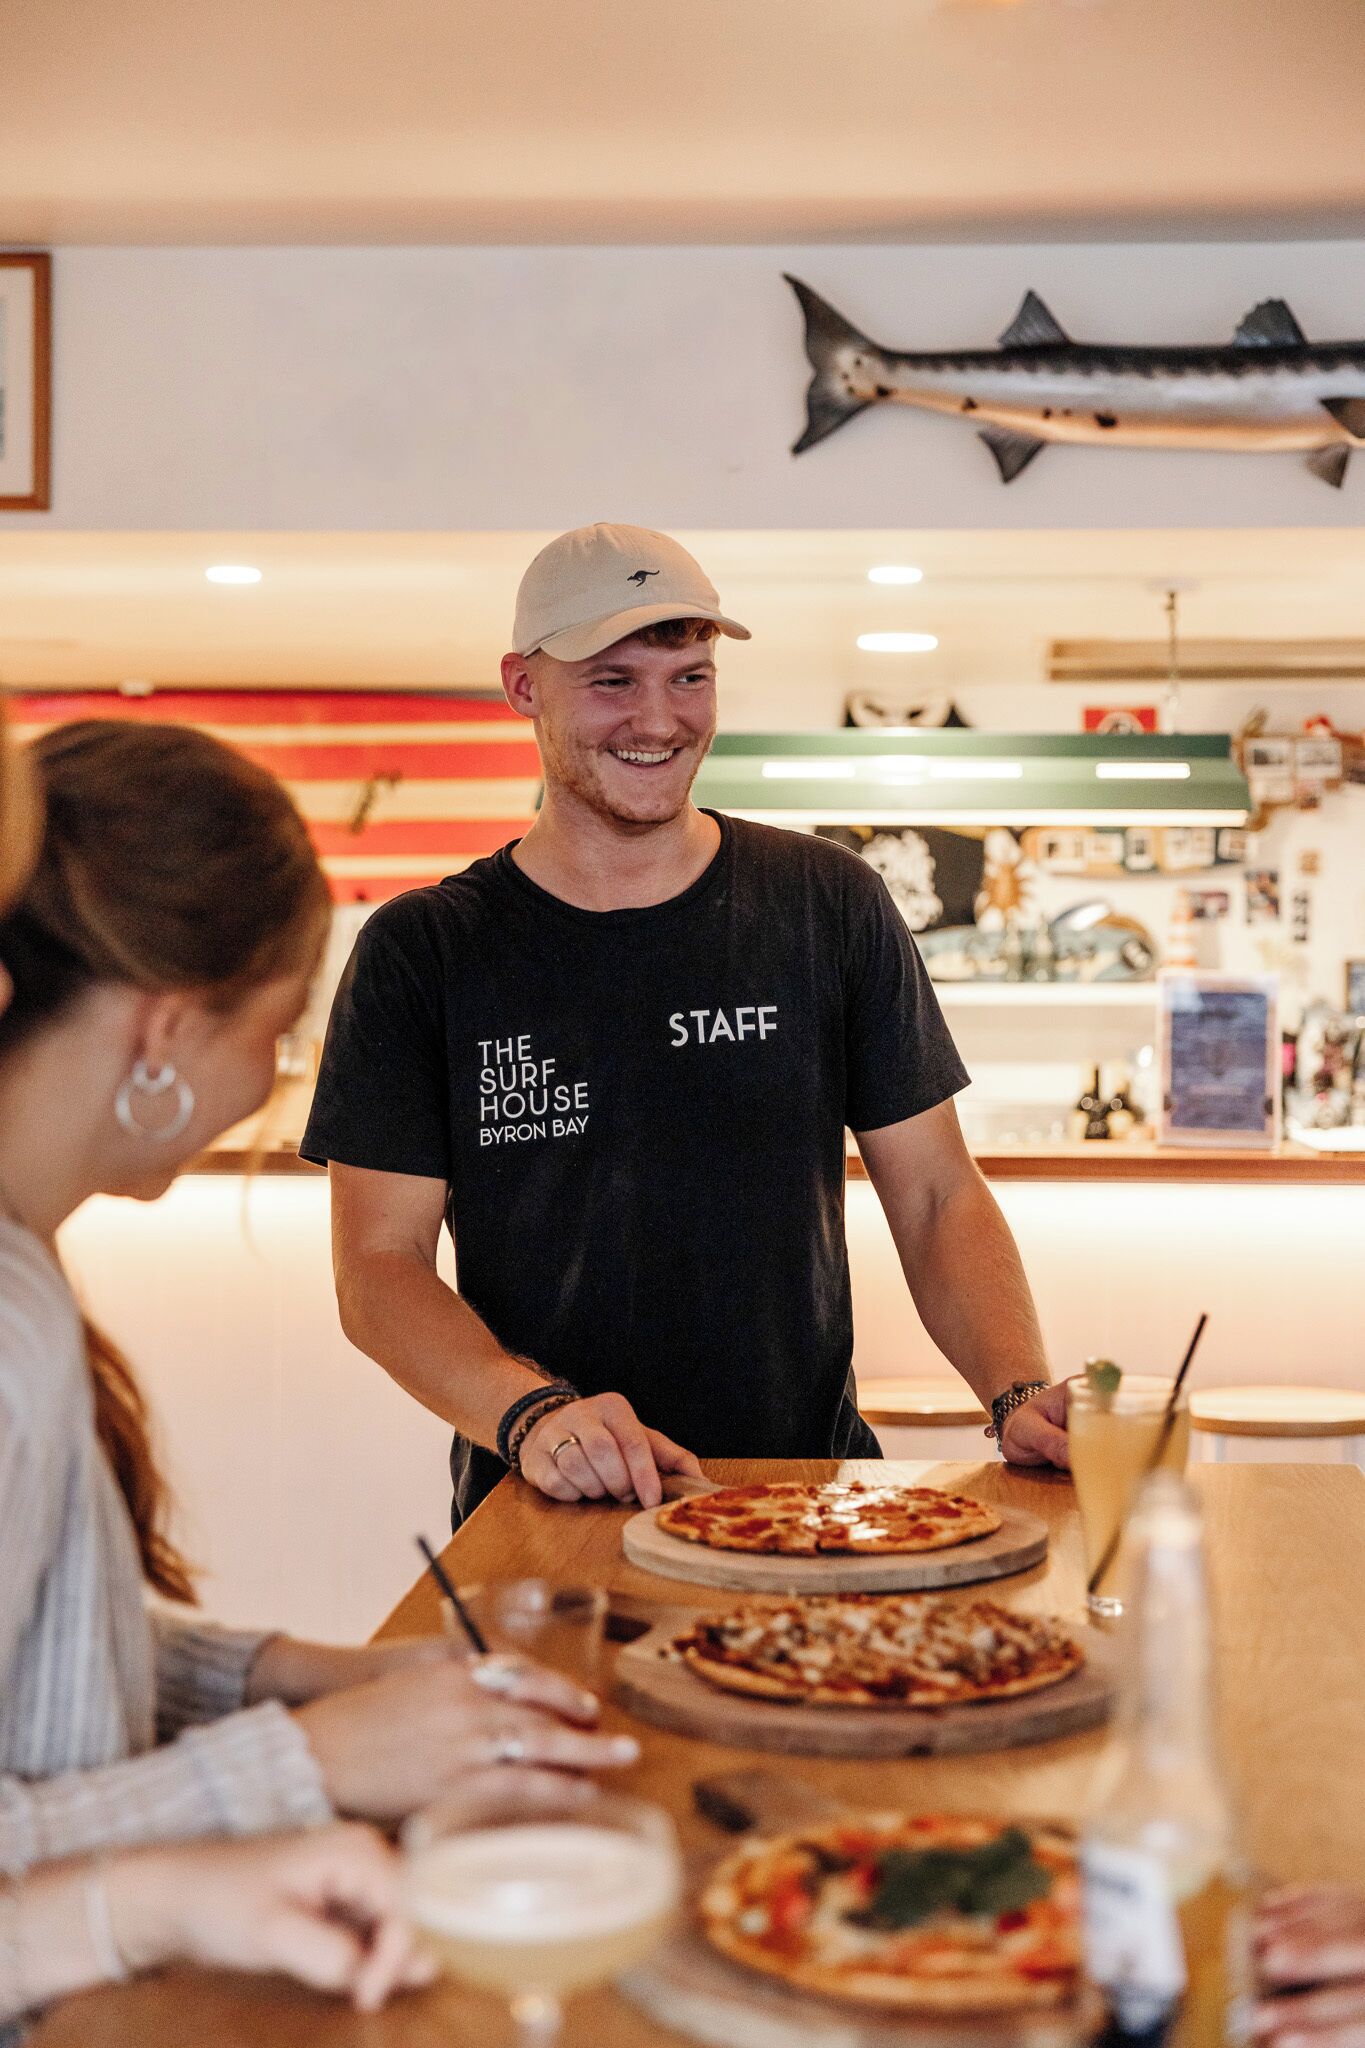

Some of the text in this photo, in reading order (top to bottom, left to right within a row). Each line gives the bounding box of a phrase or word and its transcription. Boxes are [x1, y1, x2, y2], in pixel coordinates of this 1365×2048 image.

[669, 1005, 778, 1047] STAFF
[478, 1034, 532, 1066] THE
[479, 1058, 556, 1094] SURF
[480, 1082, 590, 1122] HOUSE
[480, 1115, 590, 1146] BYRON BAY
